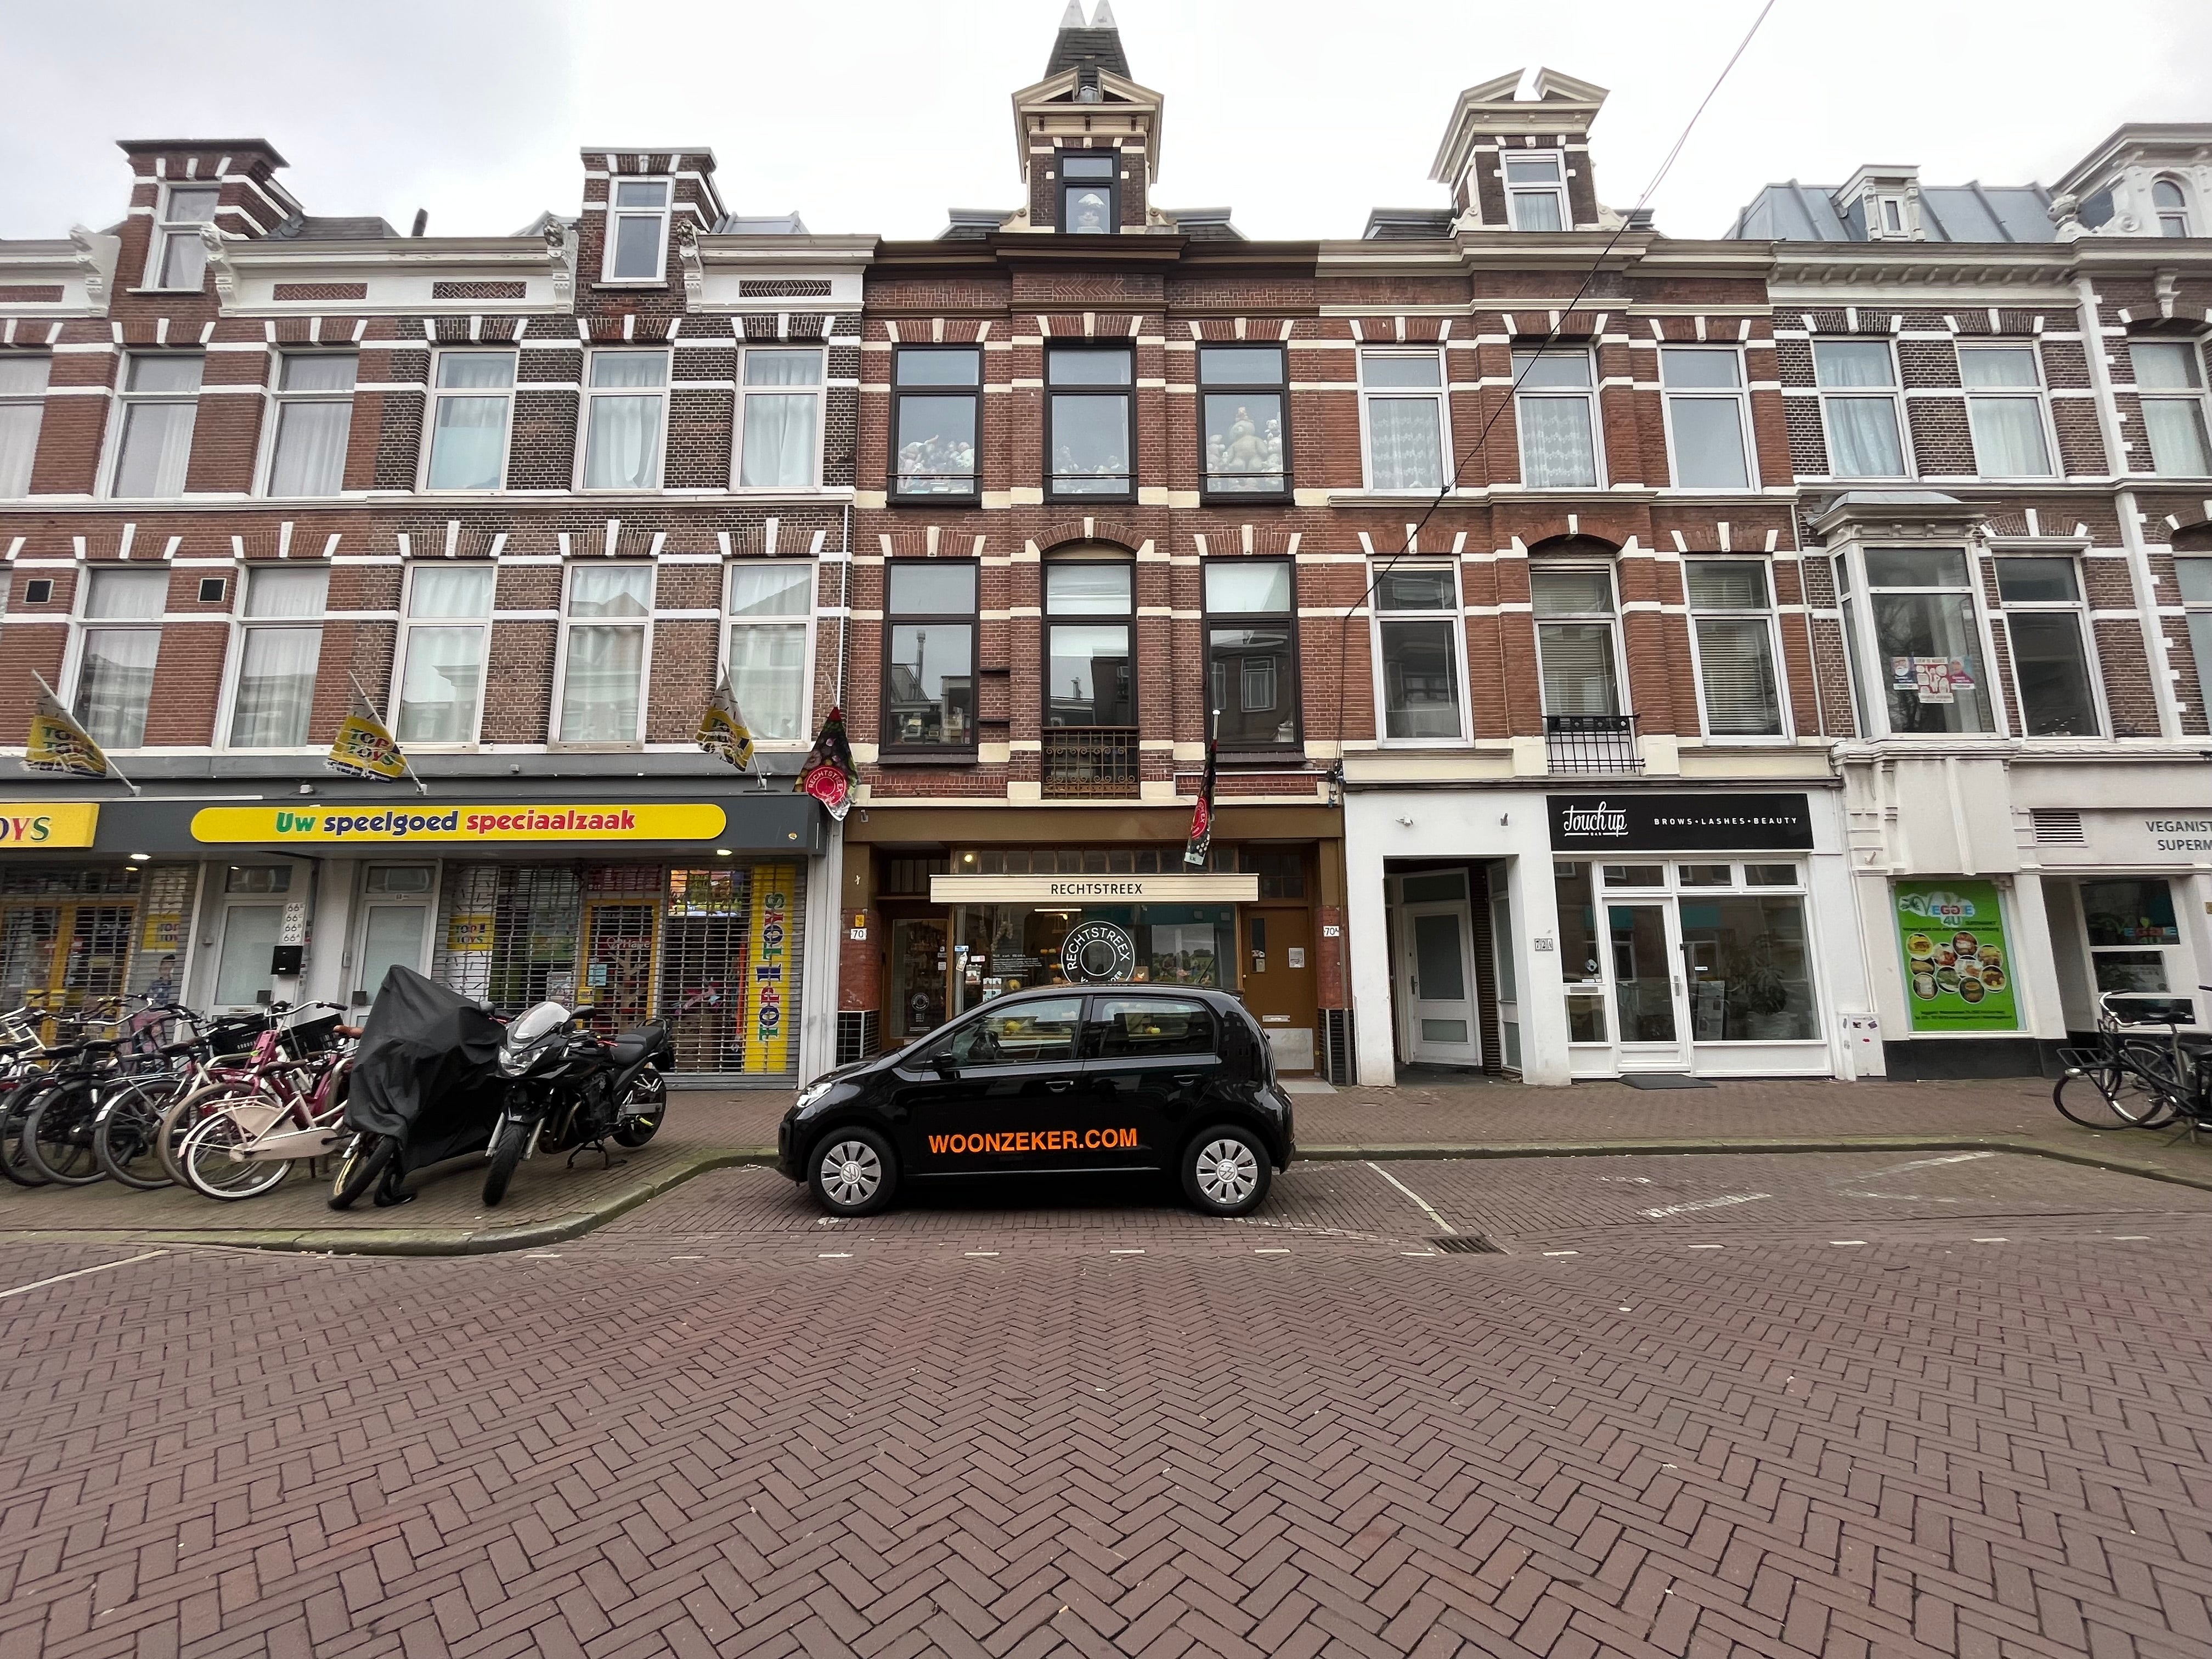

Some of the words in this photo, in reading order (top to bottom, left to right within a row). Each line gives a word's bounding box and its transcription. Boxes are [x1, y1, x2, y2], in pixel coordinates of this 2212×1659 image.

[276, 812, 317, 833] Uw
[324, 811, 459, 836] speelgoed
[466, 810, 635, 834] speciaalzaak
[1607, 814, 1628, 838] up
[1051, 883, 1143, 895] RECHTSTREEX
[853, 930, 864, 938] 70
[1066, 927, 1130, 970] RECHTSTREEX
[928, 1128, 1137, 1153] WOONZEKER.COM
